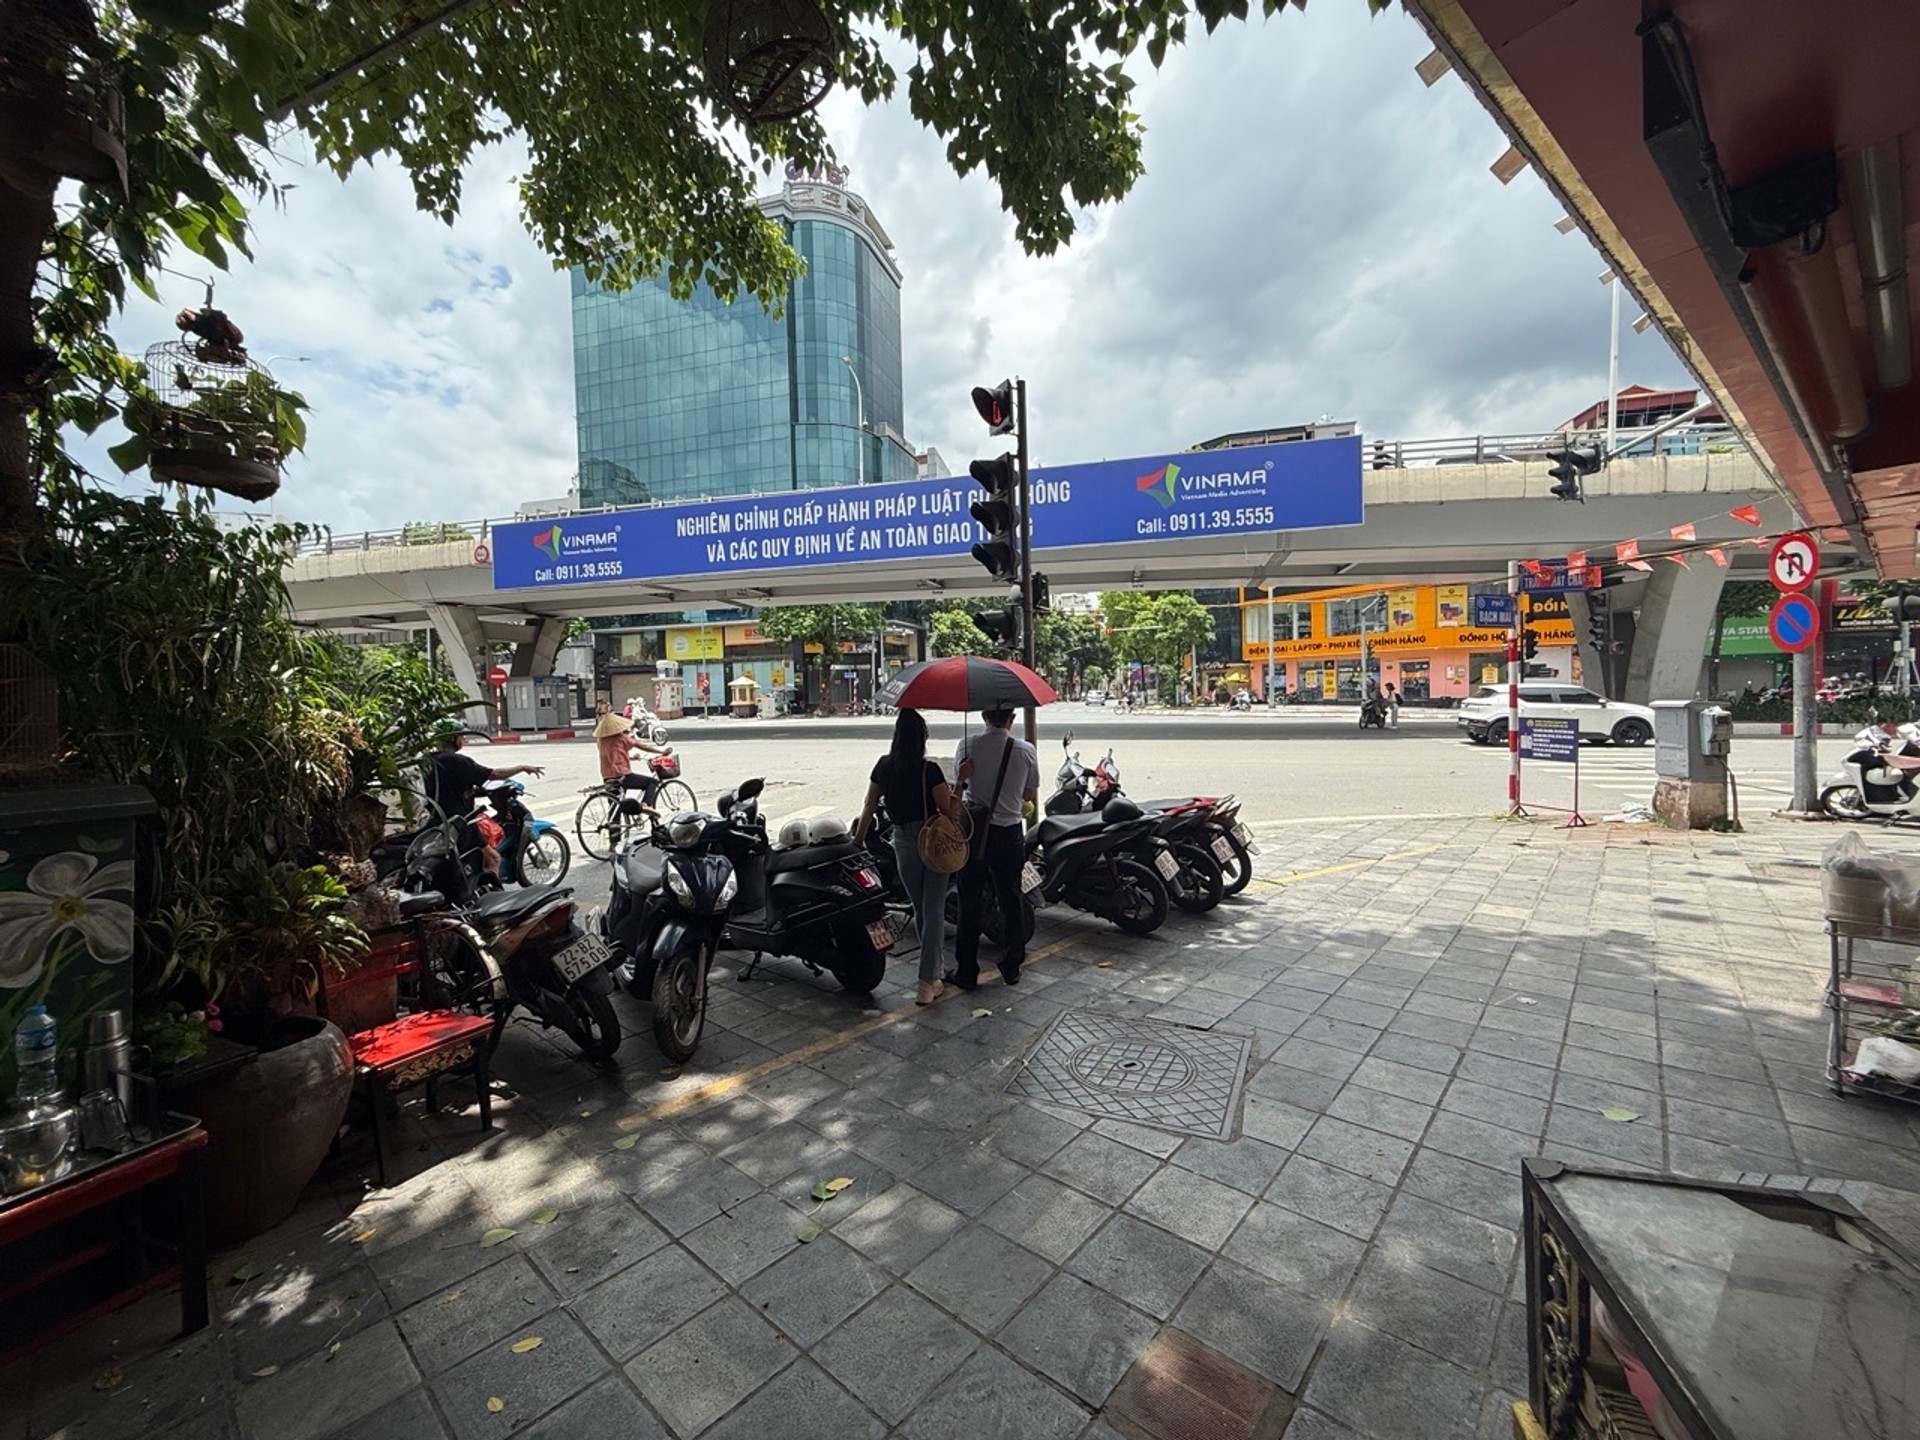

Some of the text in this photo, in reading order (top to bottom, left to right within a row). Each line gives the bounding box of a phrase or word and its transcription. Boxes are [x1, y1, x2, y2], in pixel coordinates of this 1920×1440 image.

[1180, 469, 1266, 491] VINAMA
[676, 511, 731, 537] NGHIÊM
[735, 505, 779, 532] CHỈNH
[783, 499, 823, 527] CHẤP
[827, 499, 870, 523] HÀNH
[875, 491, 917, 519] PHÁP
[921, 488, 963, 517] LUẬT
[1137, 506, 1274, 534] Call: 0911.39.5555
[562, 532, 617, 548] VINAMA
[707, 540, 726, 563] VÀ
[730, 537, 758, 561] CÁC
[762, 537, 791, 560] QUY
[794, 533, 831, 559] ĐỊNH
[835, 525, 857, 553] VỀ
[860, 529, 881, 550] AN
[885, 522, 928, 549] TOÀN
[933, 521, 972, 545] GIAO
[535, 561, 622, 582] Call: 0911.39.5555
[564, 948, 608, 979] 575.09
